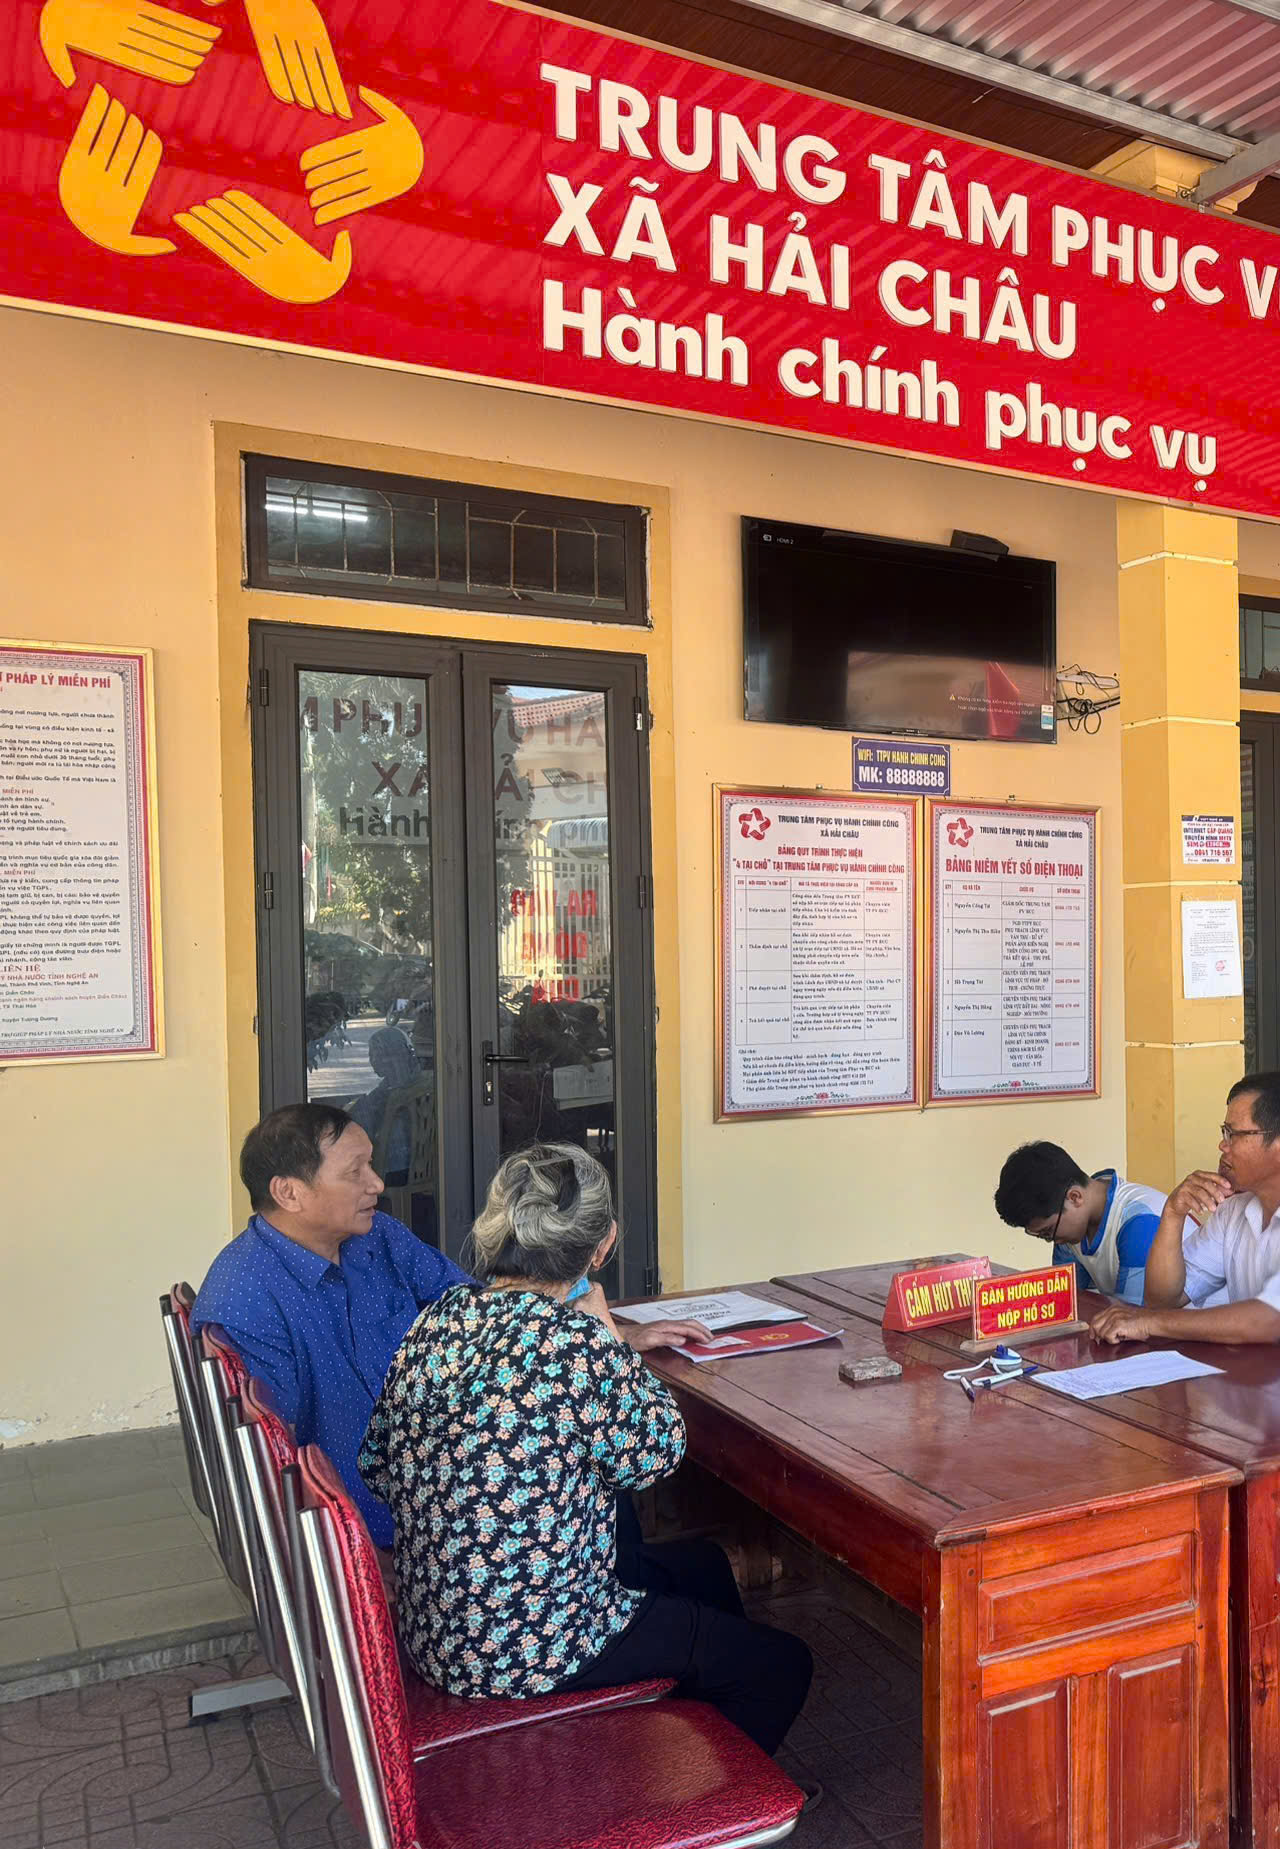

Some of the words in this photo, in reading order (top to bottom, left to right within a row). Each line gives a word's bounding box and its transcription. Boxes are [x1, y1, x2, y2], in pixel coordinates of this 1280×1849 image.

[541, 63, 847, 205] TRUNG
[868, 148, 1029, 258] TÂM
[1052, 204, 1225, 313] PHỤC
[543, 173, 677, 274] XÃ
[710, 210, 852, 312] HẢI
[878, 266, 1078, 361] CHÂU
[542, 278, 750, 386] Hành
[777, 337, 961, 429] chính
[985, 381, 1133, 473] phục
[1150, 422, 1218, 493] vụ
[6, 672, 38, 684] PHÁP
[41, 673, 54, 686] LÝ
[58, 673, 88, 687] MIỄN
[92, 676, 111, 688] PHÍ
[858, 766, 883, 784] MK:
[886, 767, 945, 787] 88888888
[945, 854, 972, 873] BẢNG
[974, 857, 998, 875] NIÊM
[1001, 857, 1018, 875] YẾT
[1020, 857, 1032, 875] SỐ
[1034, 860, 1056, 878] ĐIỆN
[1057, 863, 1083, 880] THOẠI
[905, 1276, 931, 1319] CẤM
[932, 1274, 955, 1312] HÚT
[981, 1286, 1005, 1306] BÀN
[1007, 1279, 1044, 1301] HƯỚNG
[1047, 1272, 1069, 1294] DẪN
[997, 1308, 1020, 1330] NỘP
[1023, 1302, 1038, 1323] HỒ
[1041, 1300, 1056, 1319] SƠ
